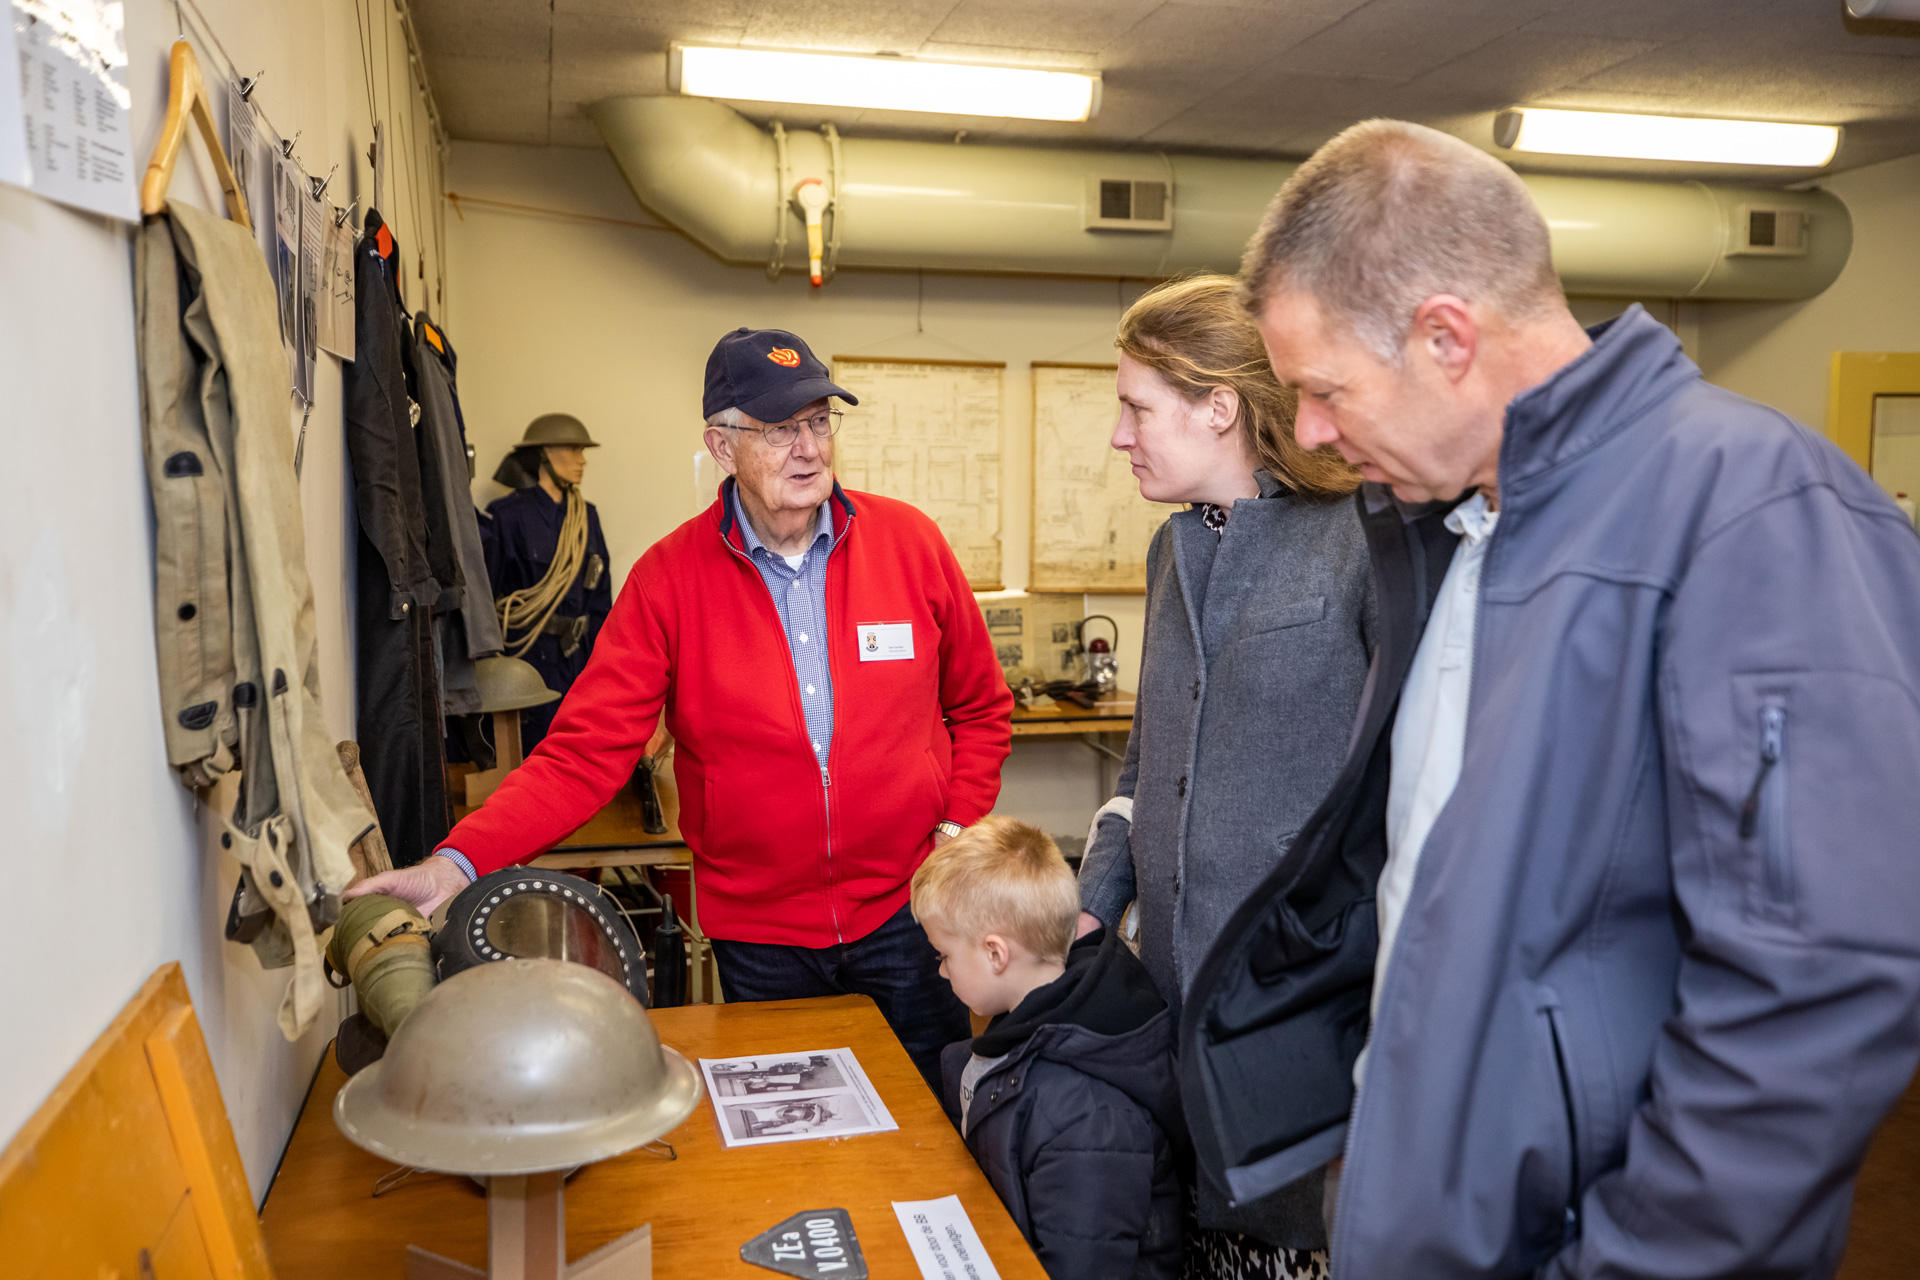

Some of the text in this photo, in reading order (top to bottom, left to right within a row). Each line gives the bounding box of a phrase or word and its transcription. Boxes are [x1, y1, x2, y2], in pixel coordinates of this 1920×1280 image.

[913, 1213, 928, 1224] BB
[921, 1224, 933, 1235] de
[805, 1218, 849, 1273] V.0400
[926, 1235, 942, 1252] door
